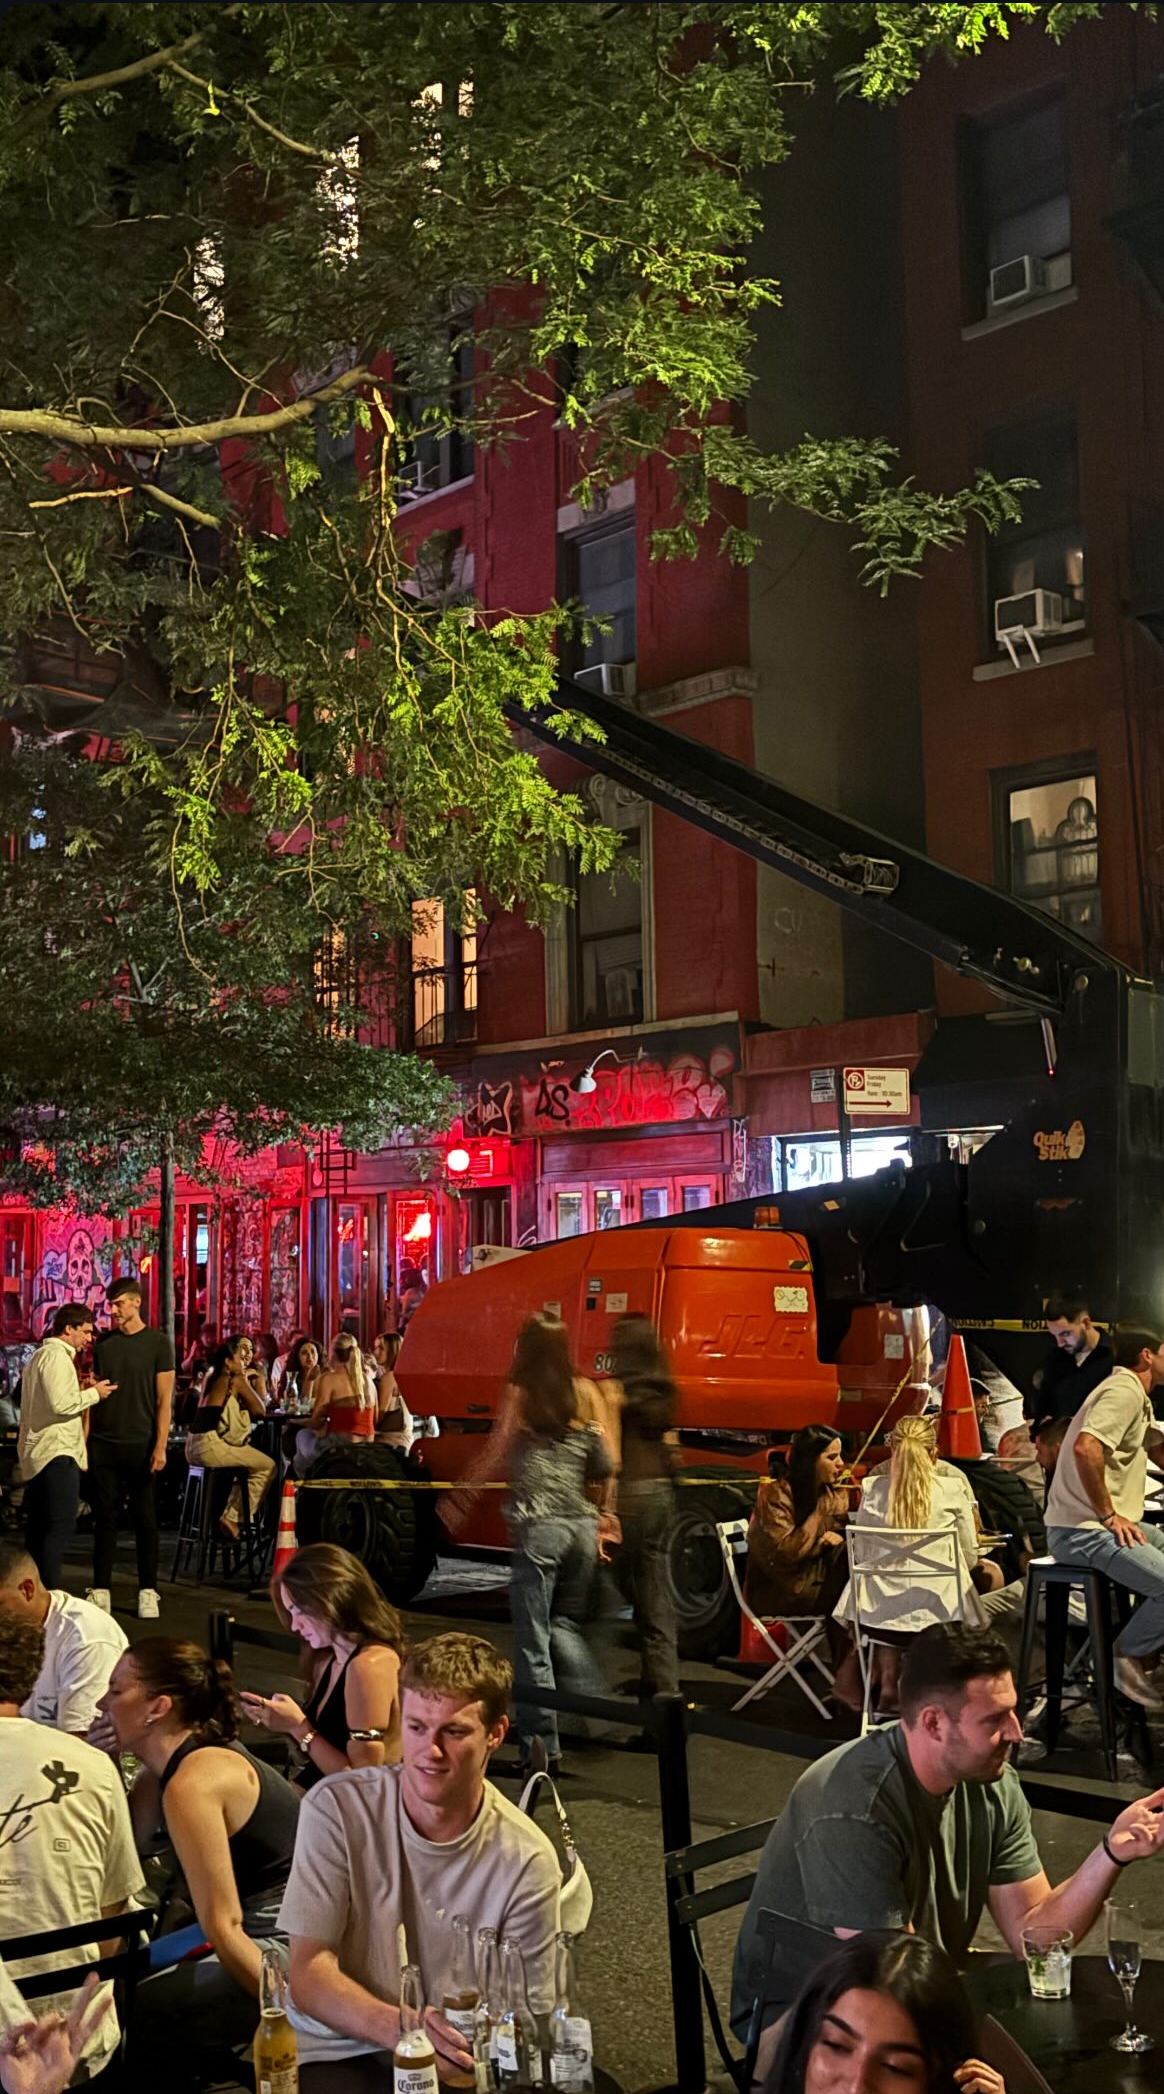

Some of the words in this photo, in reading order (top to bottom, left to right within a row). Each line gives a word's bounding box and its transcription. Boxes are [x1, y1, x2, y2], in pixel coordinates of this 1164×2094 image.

[1033, 1130, 1066, 1148] Quik
[1038, 1146, 1068, 1160] Stik
[594, 1353, 615, 1373] 80
[397, 2079, 435, 2094] Corona
